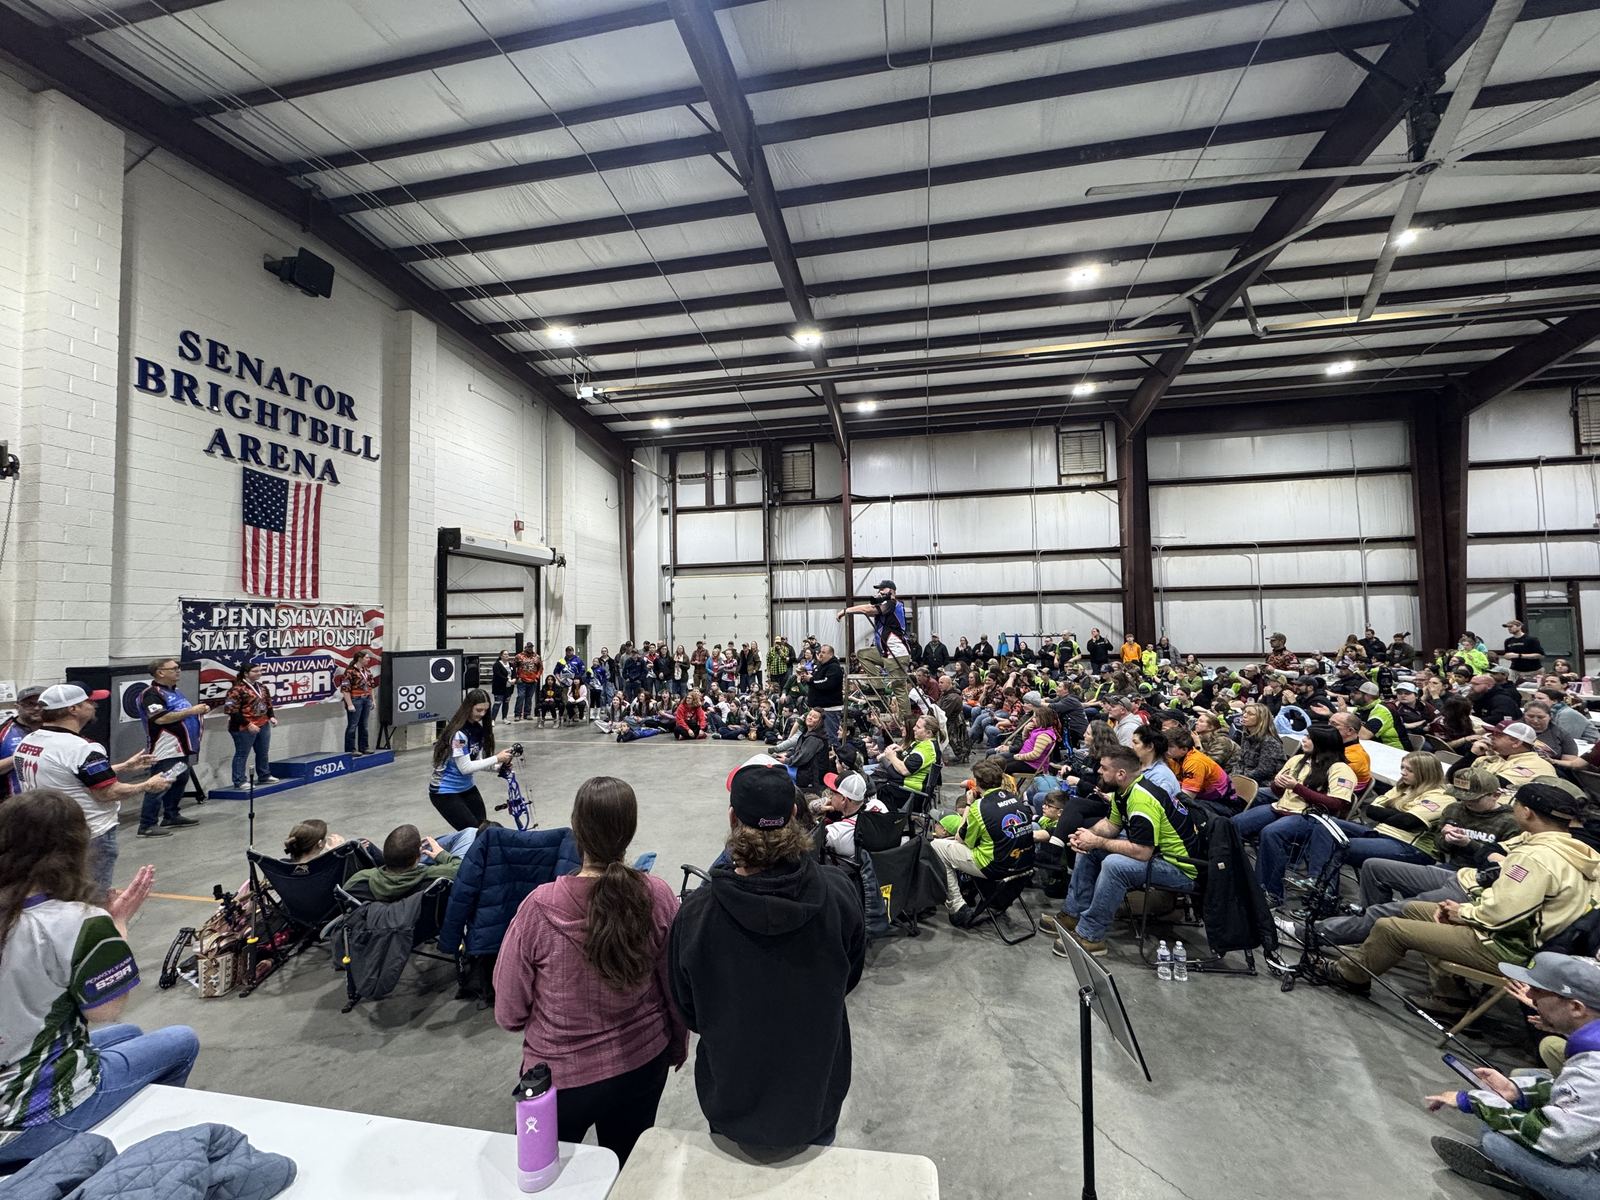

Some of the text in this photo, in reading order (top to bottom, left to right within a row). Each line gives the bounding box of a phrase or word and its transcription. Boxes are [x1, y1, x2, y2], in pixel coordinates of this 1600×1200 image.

[178, 330, 358, 421] SENATOR
[134, 357, 380, 462] BRIGHTBILL
[203, 428, 340, 485] ARENA
[211, 607, 366, 628] PENNSYLVANIA
[189, 629, 375, 651] STATE CHAMPIONSHIP
[276, 693, 313, 703] ARCHERY
[313, 760, 345, 777] S3DA
